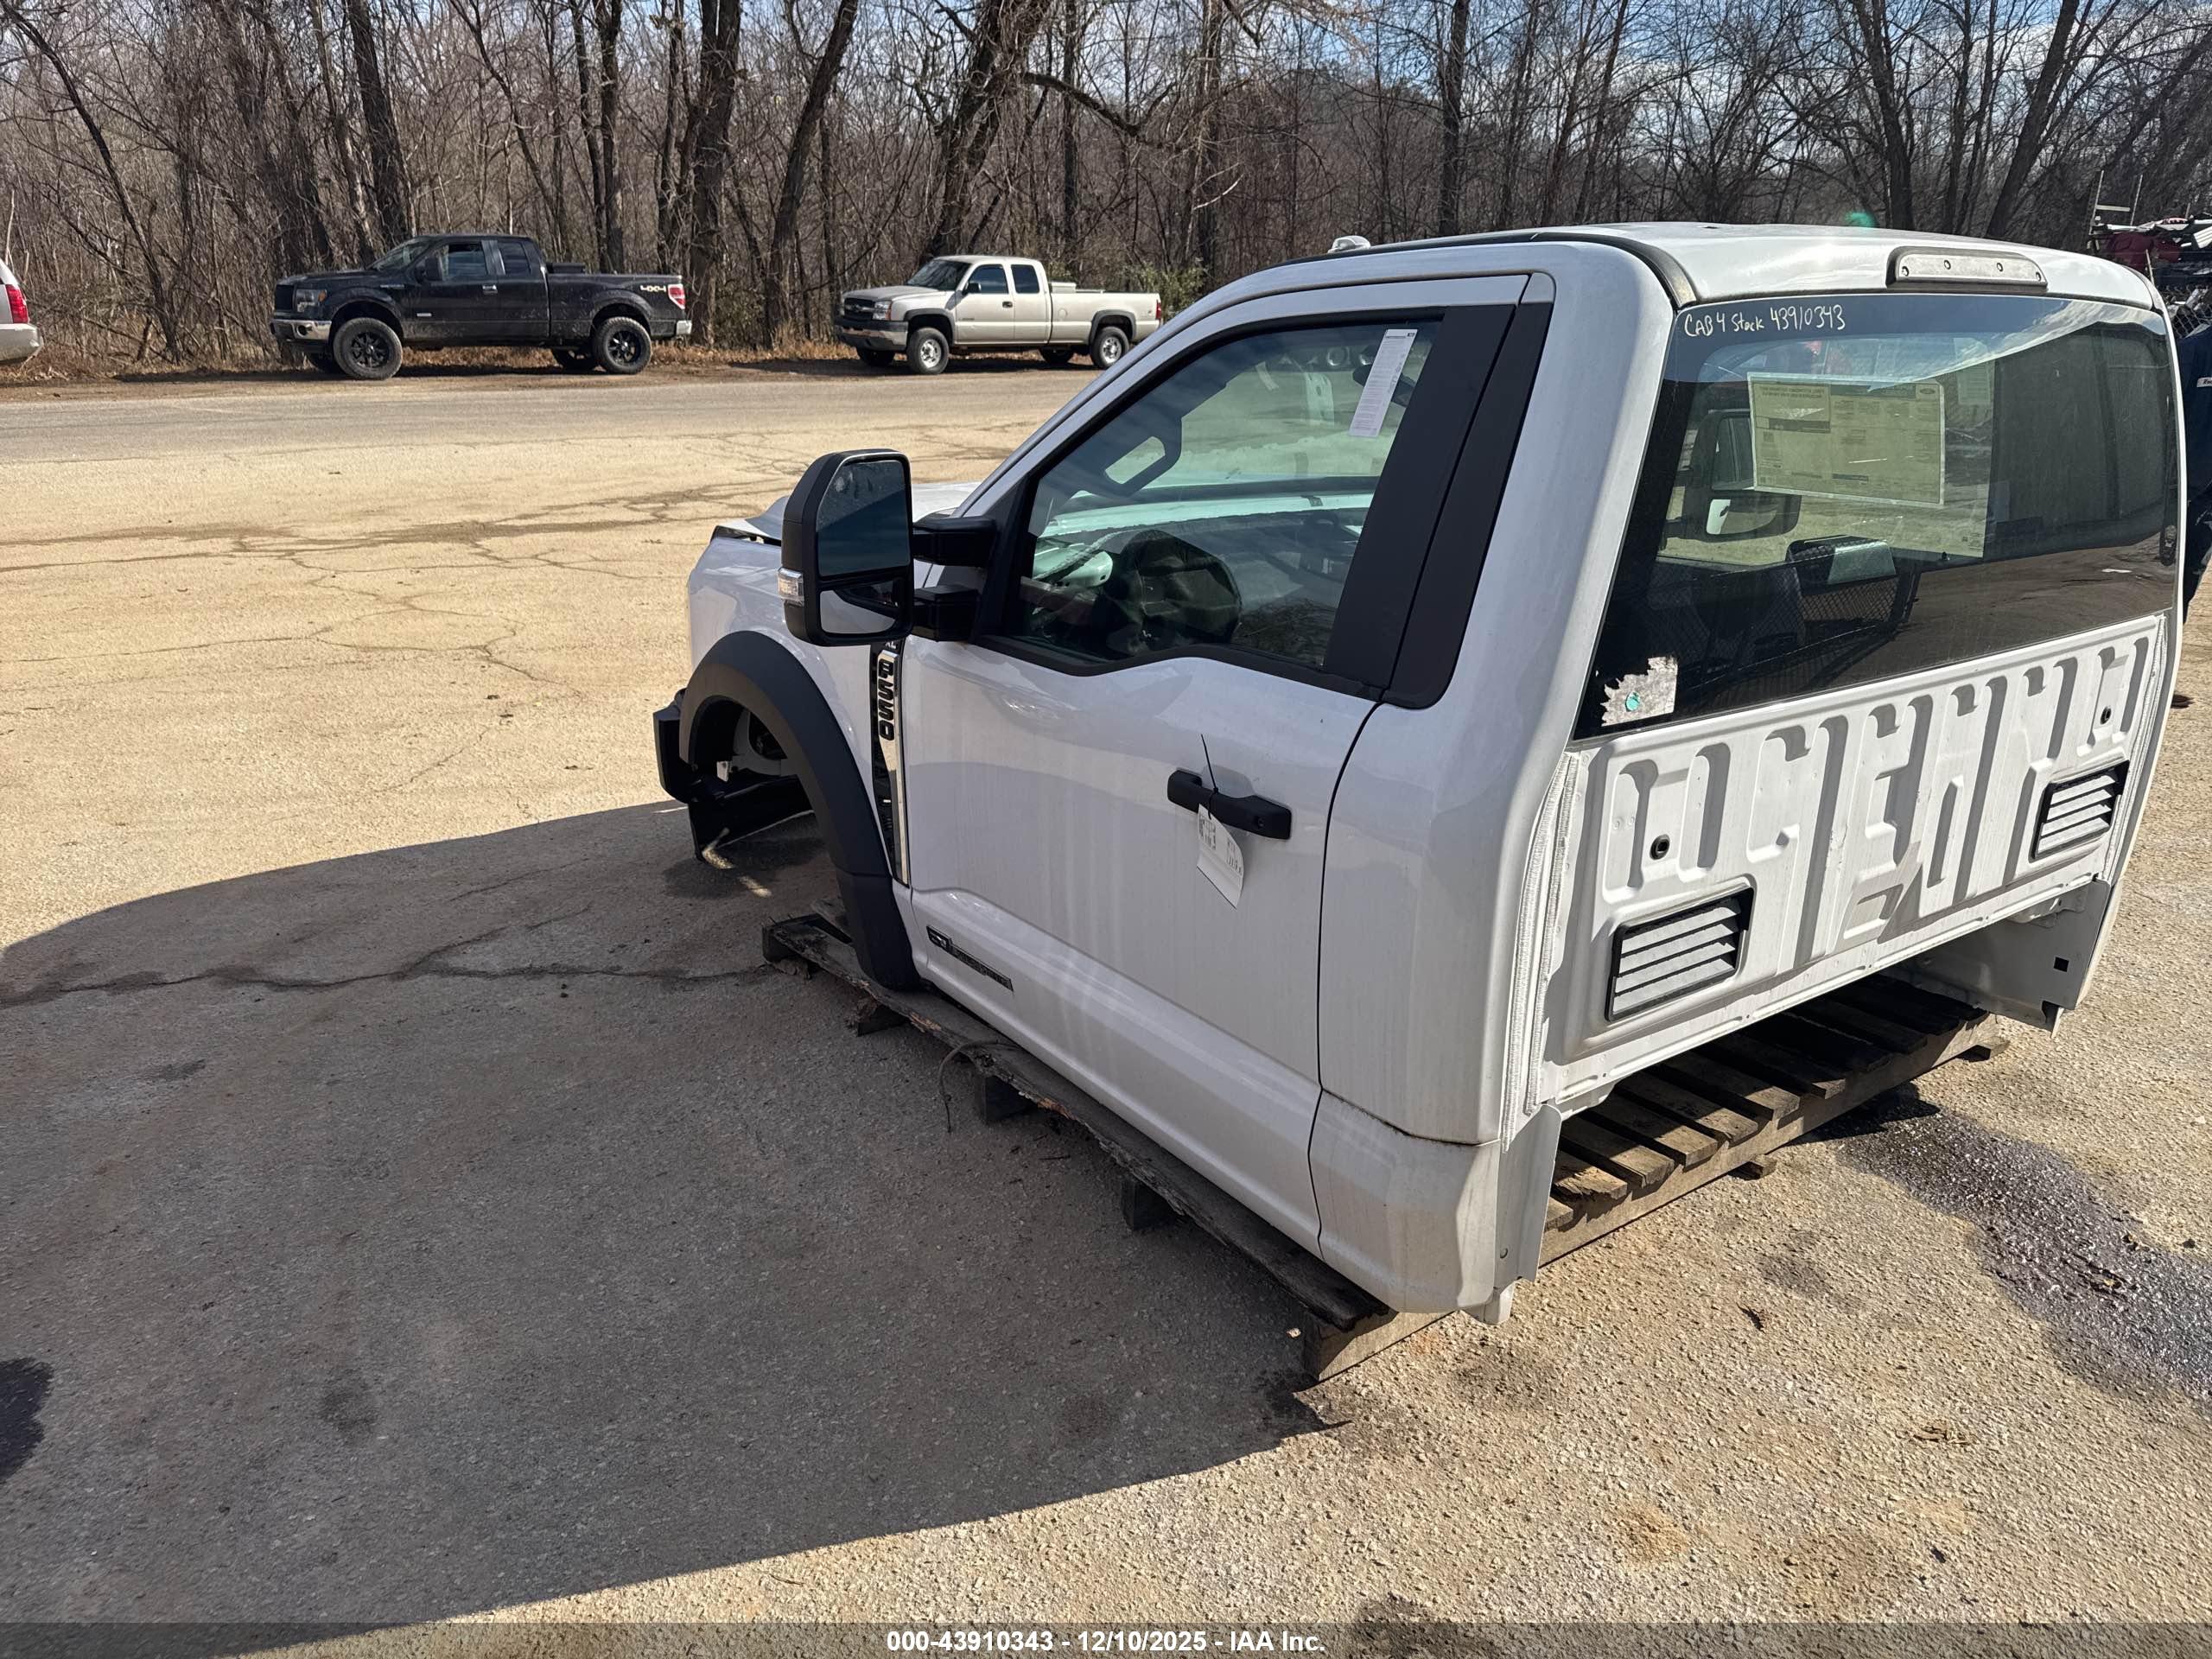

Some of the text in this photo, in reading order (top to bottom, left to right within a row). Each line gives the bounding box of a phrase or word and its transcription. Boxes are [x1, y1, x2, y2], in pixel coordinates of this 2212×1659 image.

[1684, 304, 1846, 337] CAB 4 Stock 43910343
